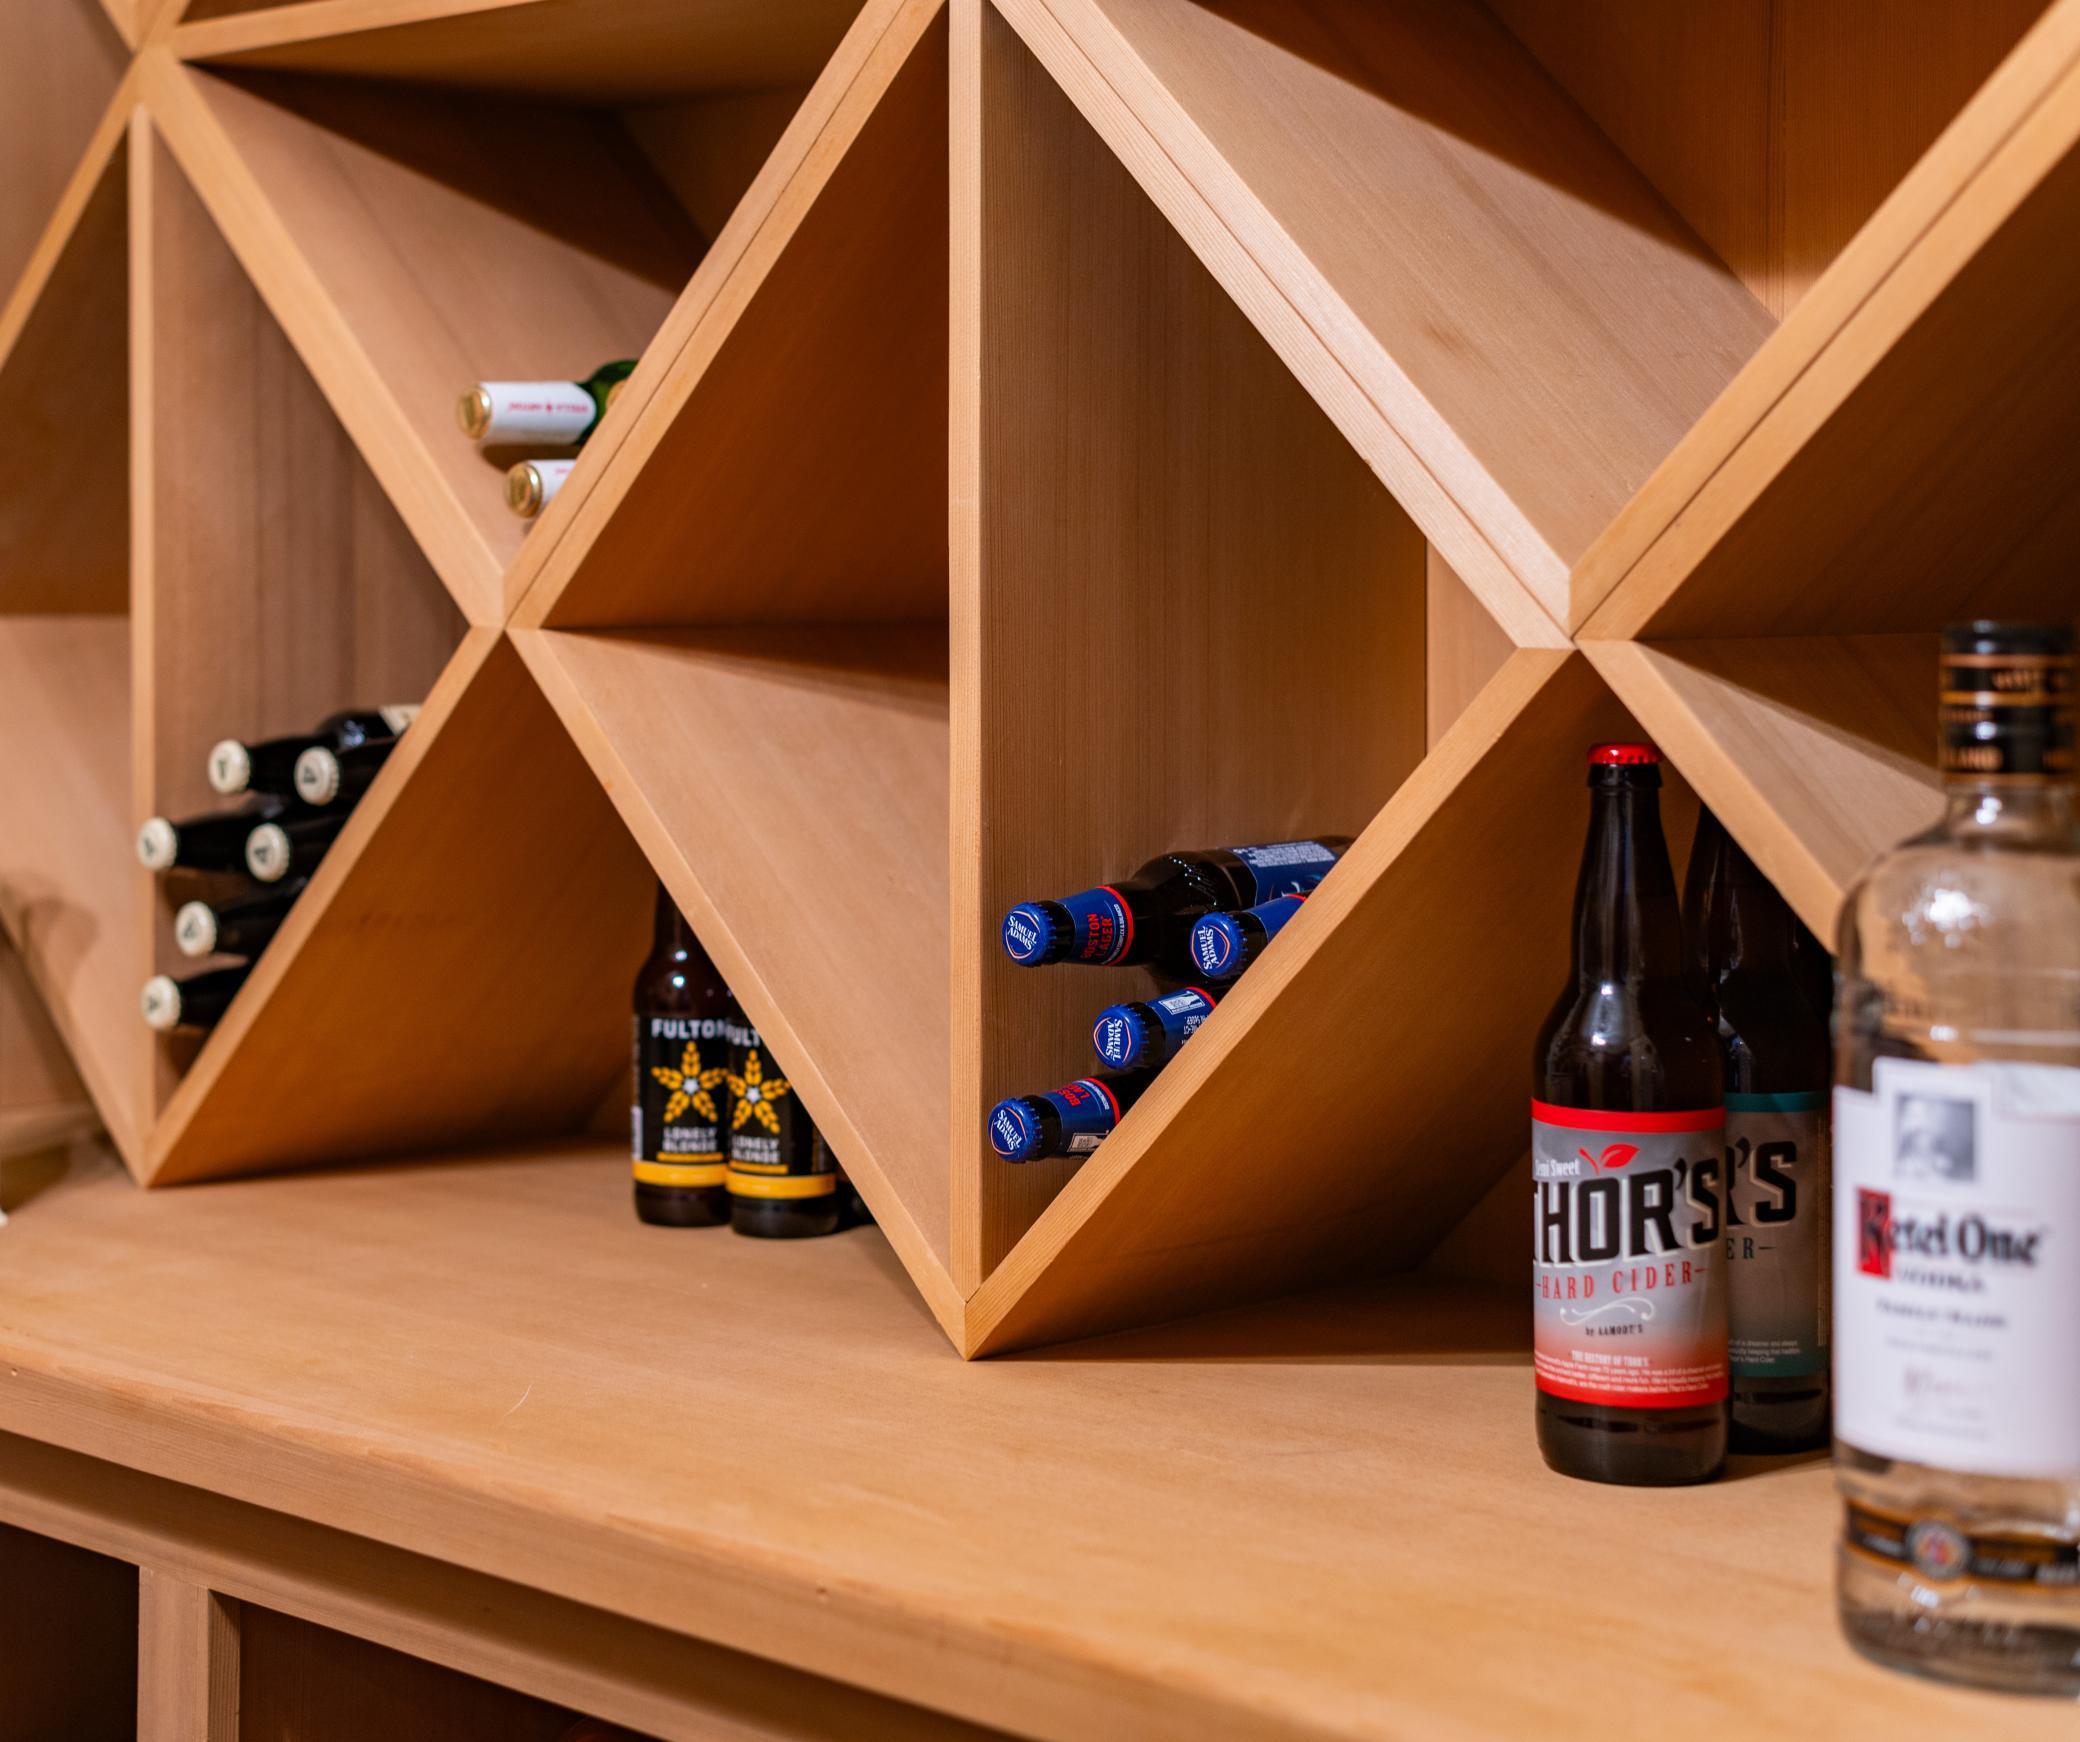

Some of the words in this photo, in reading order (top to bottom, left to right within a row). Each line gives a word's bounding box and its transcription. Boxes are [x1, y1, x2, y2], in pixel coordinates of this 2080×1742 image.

[1007, 928, 1033, 951] ADAMS
[1008, 914, 1037, 945] SAMUEL
[1205, 928, 1219, 965] ADAMS
[1198, 926, 1213, 970] SAMUEL
[1105, 1020, 1115, 1057] ADAMS
[1113, 1018, 1123, 1061] SAMUEL
[662, 1139, 717, 1153] BLONDE
[663, 1126, 717, 1139] LONELY
[732, 1135, 779, 1150] LONELY
[994, 1120, 1016, 1151] ADAMS
[998, 1109, 1023, 1149] SAMUEL
[731, 1149, 780, 1164] BLONDE
[1550, 1158, 1581, 1177] Sweet
[1533, 1158, 1720, 1267] HOR'S
[1956, 1212, 2040, 1267] One
[1541, 1271, 1595, 1299] HARD
[1613, 1261, 1693, 1294] CIDER
